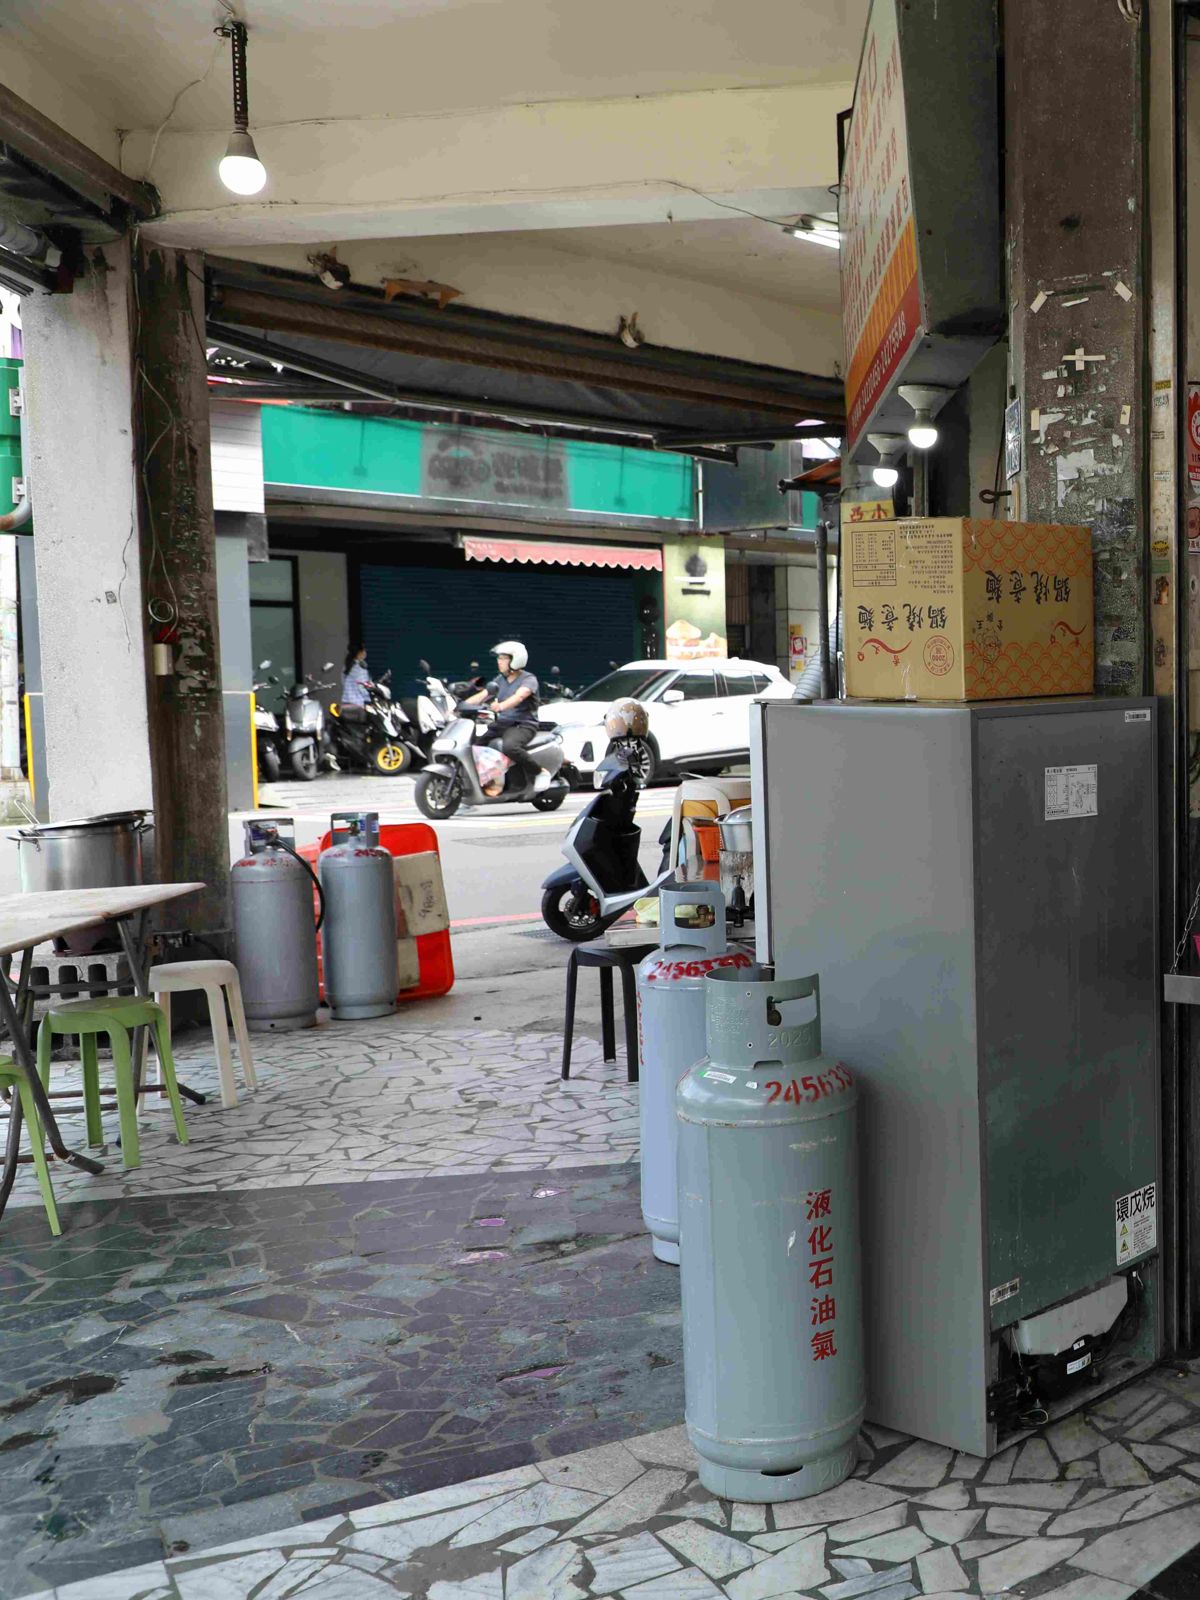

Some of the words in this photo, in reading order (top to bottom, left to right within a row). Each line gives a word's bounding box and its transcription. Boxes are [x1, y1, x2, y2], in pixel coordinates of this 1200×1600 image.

[985, 570, 1072, 605] 鍋燒意麵
[857, 603, 949, 632] 鍋燒意麵
[1117, 1186, 1155, 1222] 環戊烷
[806, 1189, 838, 1361] 液化石油氣
